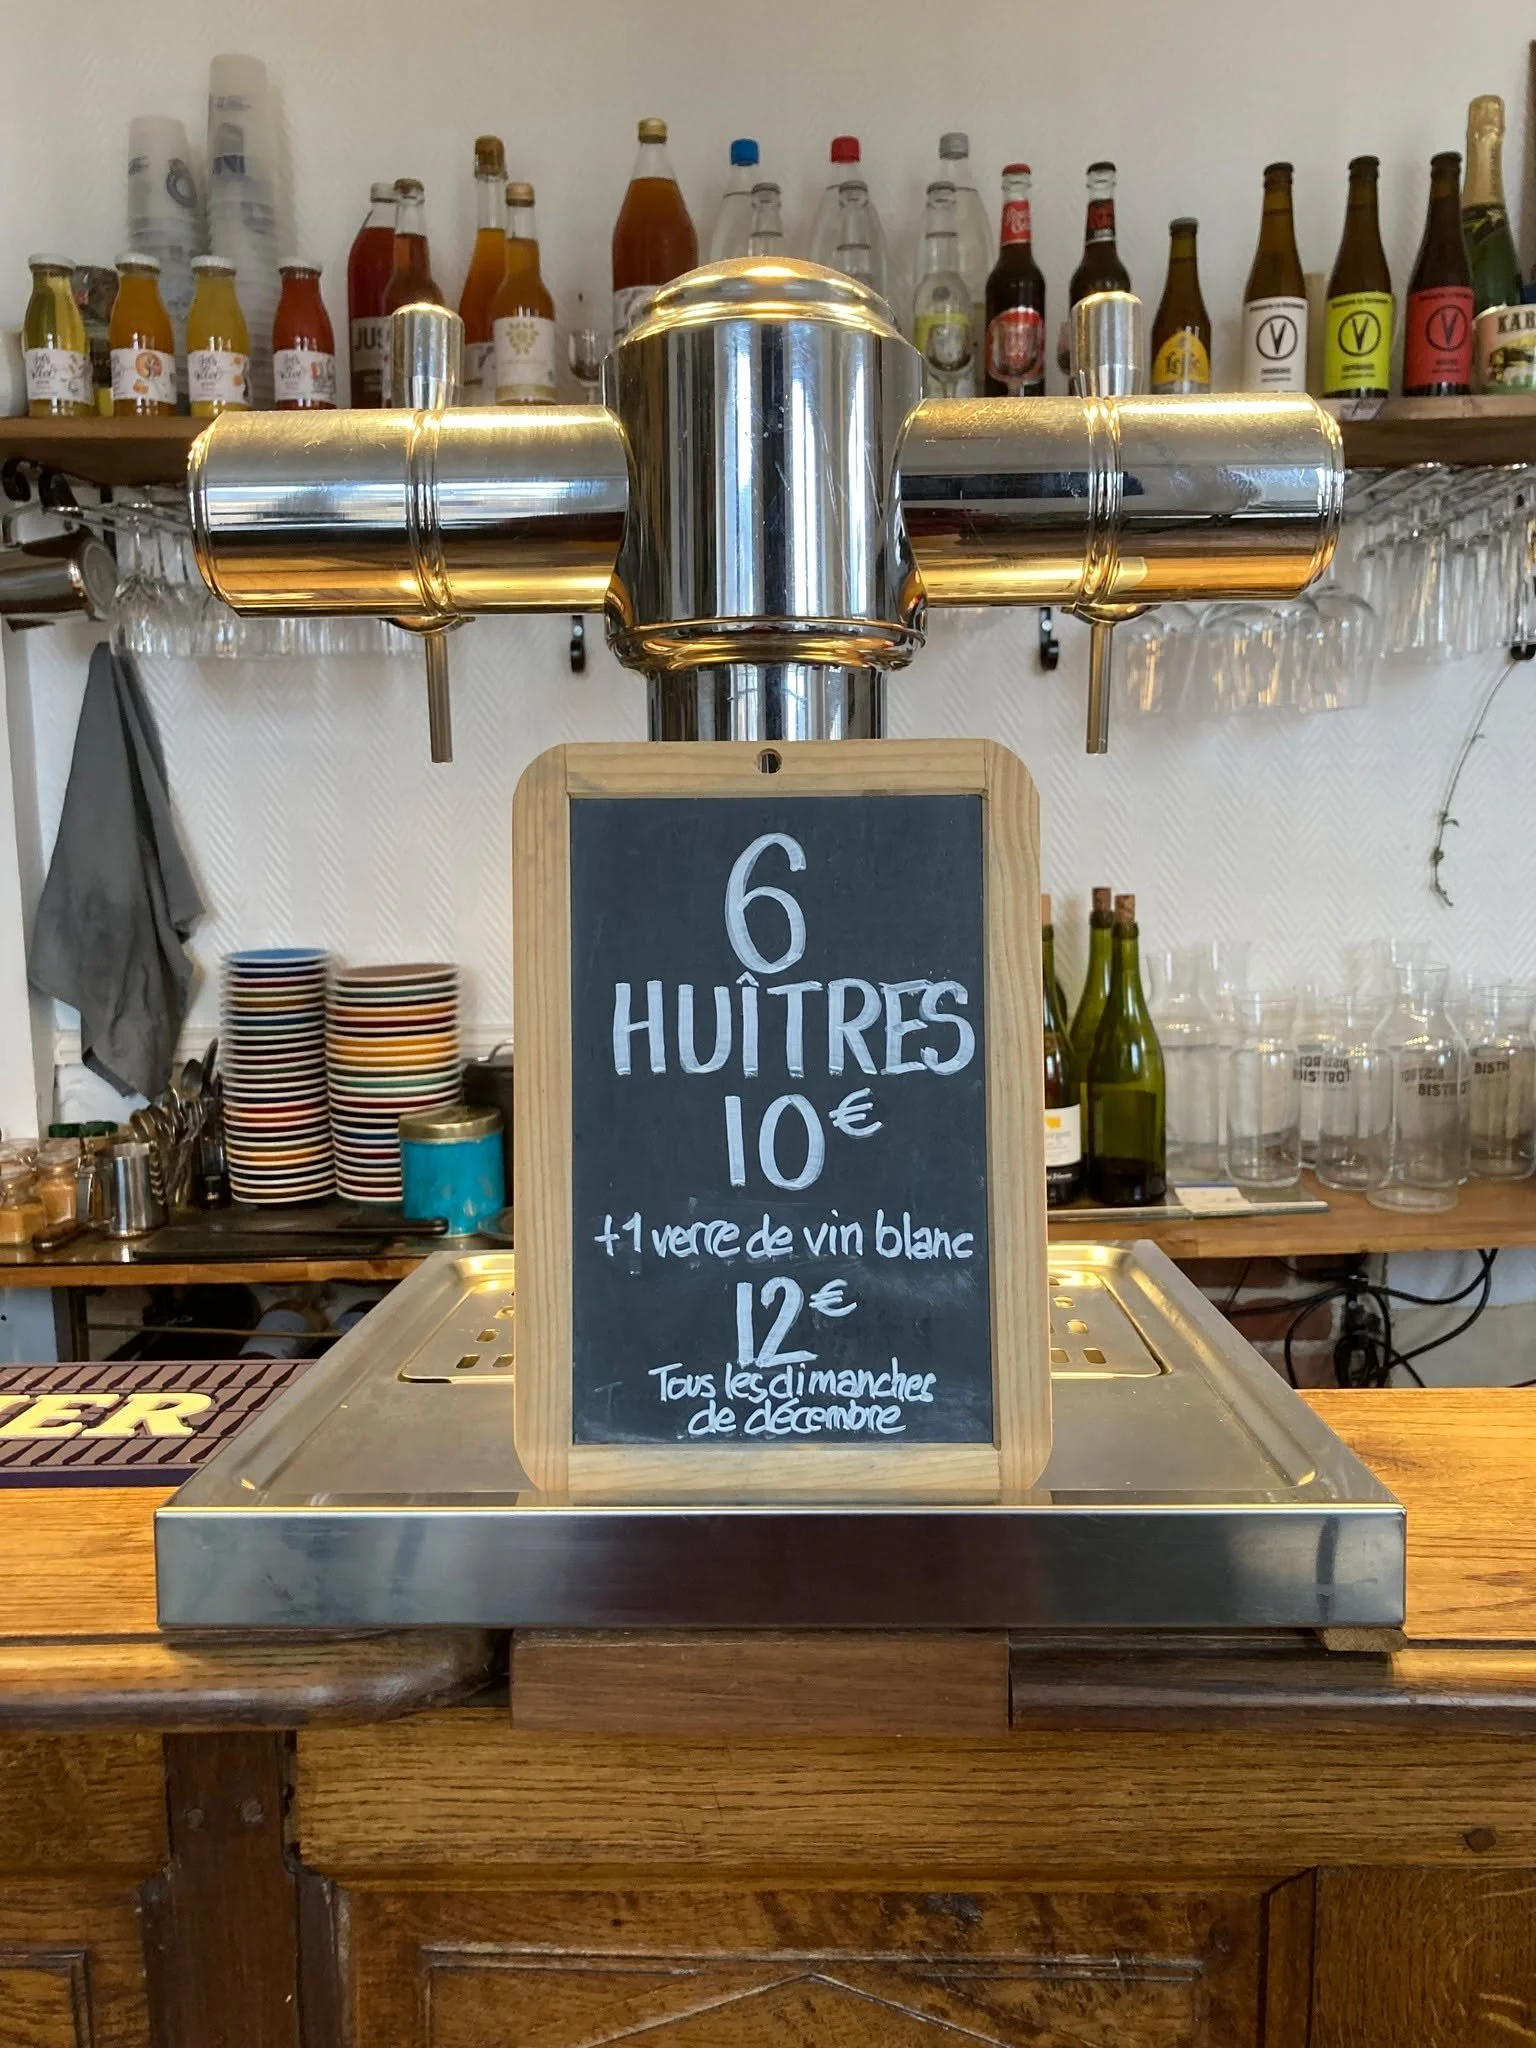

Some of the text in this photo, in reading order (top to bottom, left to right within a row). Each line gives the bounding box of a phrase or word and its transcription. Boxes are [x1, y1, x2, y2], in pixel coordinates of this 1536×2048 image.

[725, 832, 806, 974] 6
[613, 972, 976, 1078] HUÎTRES
[724, 1088, 883, 1191] 10€
[652, 1218, 741, 1258] verre
[745, 1213, 794, 1259] de
[803, 1209, 864, 1257] vin
[875, 1209, 974, 1259] blanc
[736, 1276, 857, 1368] 12€
[0, 1393, 213, 1437] ER
[648, 1357, 937, 1402] Tous les dimanches
[687, 1397, 906, 1435] de décembre
